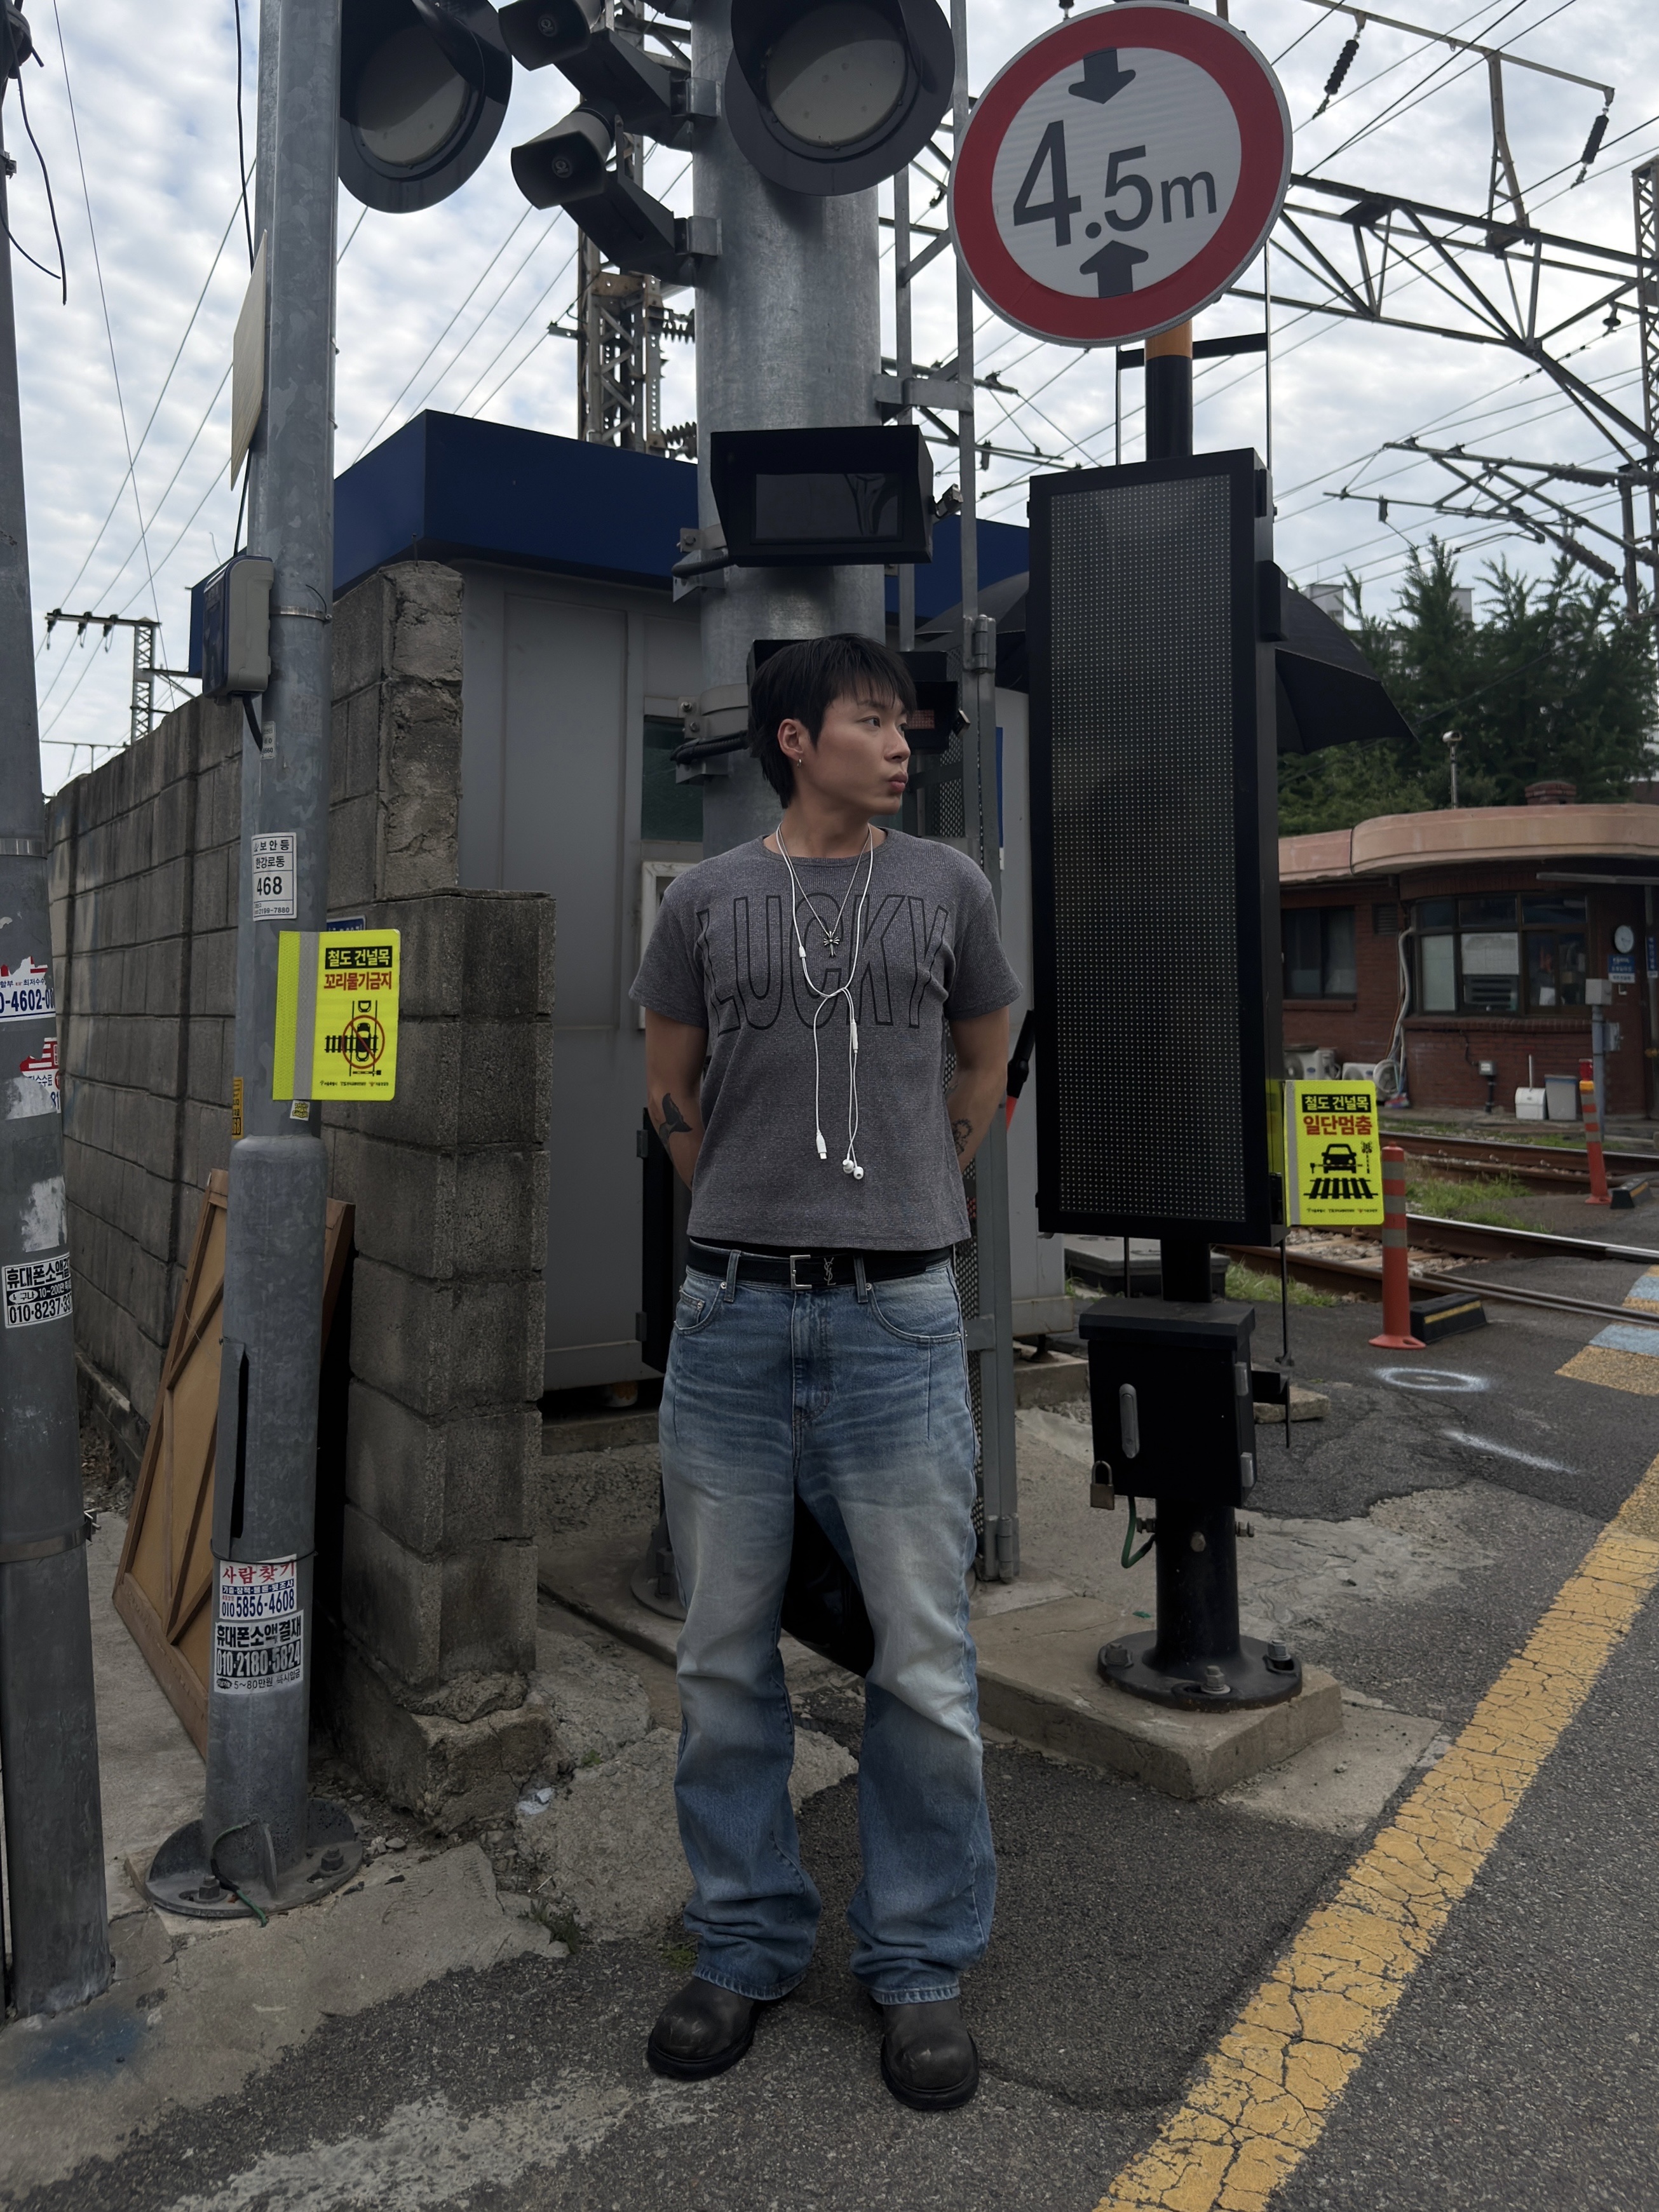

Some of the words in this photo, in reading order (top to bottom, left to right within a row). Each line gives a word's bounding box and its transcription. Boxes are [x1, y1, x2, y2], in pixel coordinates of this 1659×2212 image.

[1013, 119, 1217, 246] 4.5m
[256, 856, 285, 869] 한강로동
[257, 876, 282, 896] 468
[328, 950, 351, 967] 철도
[355, 948, 390, 966] 건널목
[696, 893, 949, 1037] LUCKY
[323, 971, 392, 991] 꼬리물기금지
[1304, 1096, 1330, 1110] 철도
[1332, 1096, 1369, 1110] 건널목
[1303, 1115, 1372, 1135] 일단멈춤
